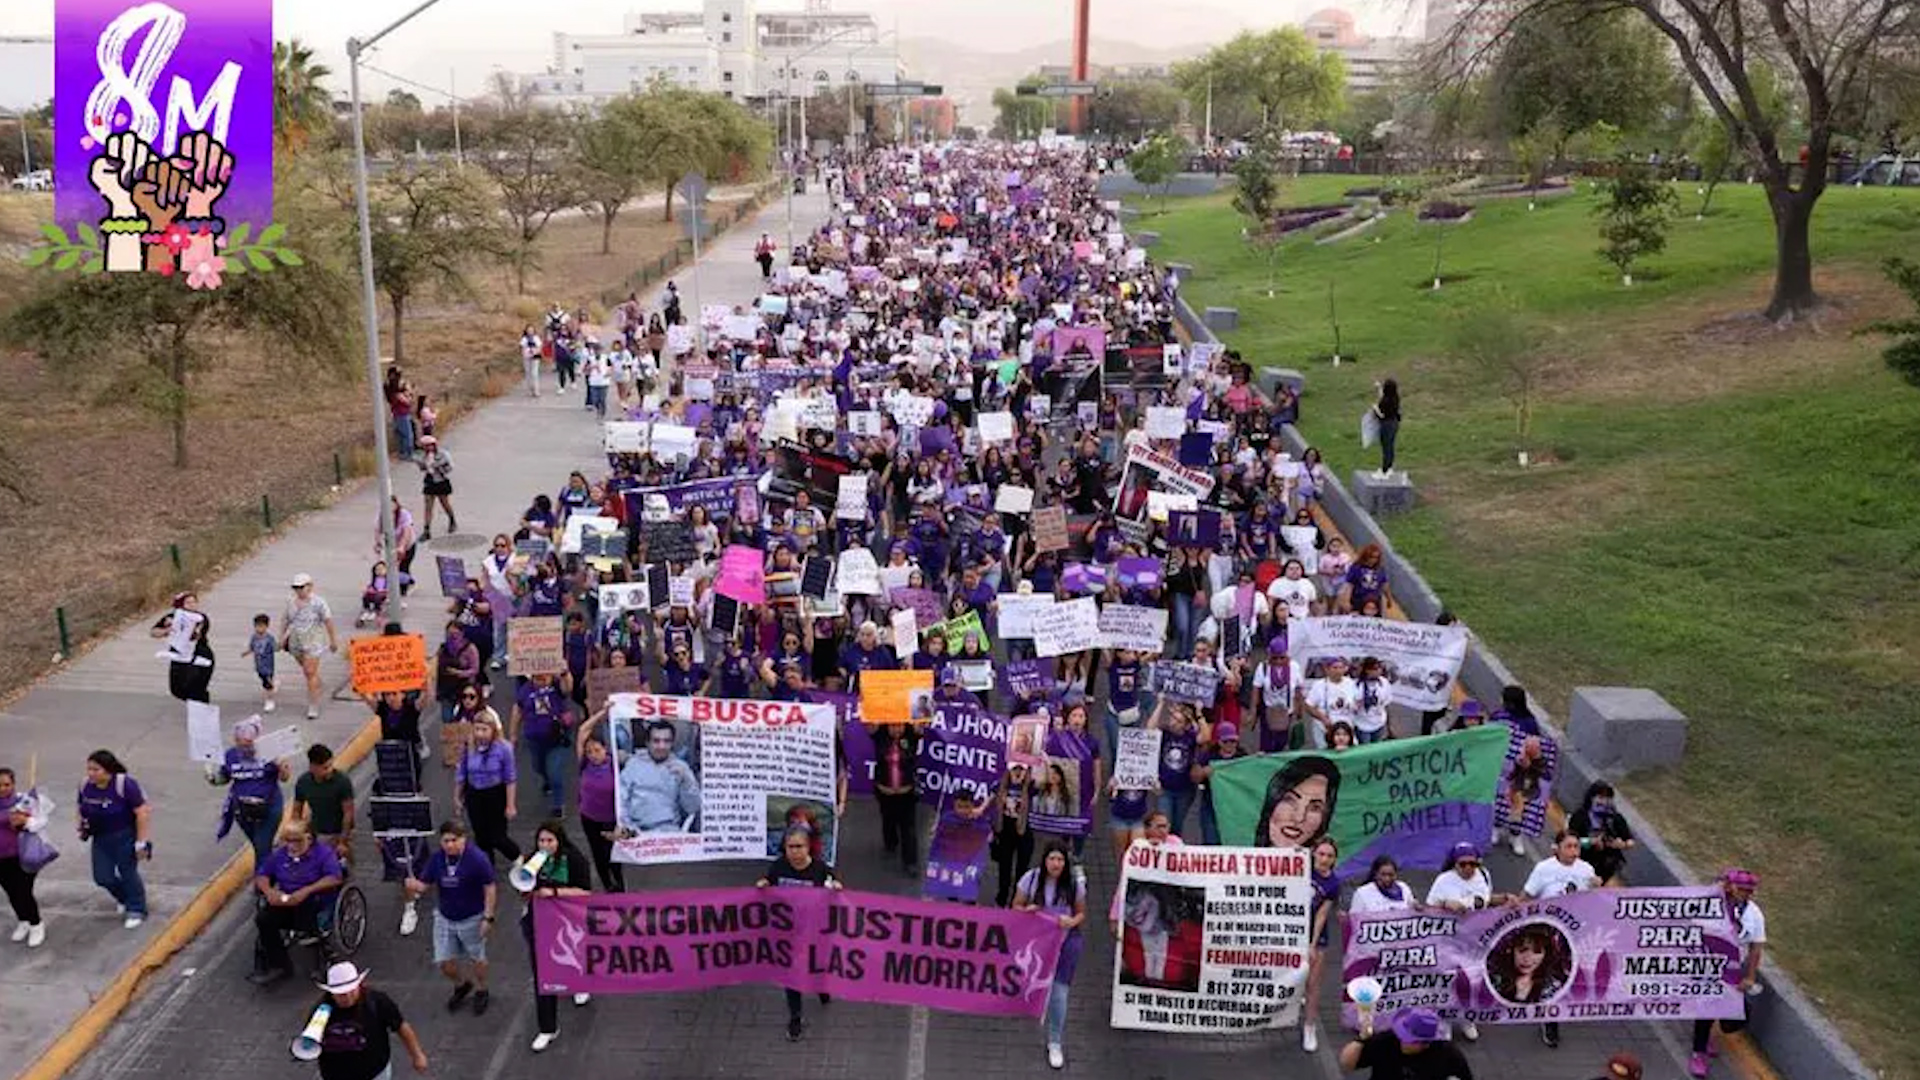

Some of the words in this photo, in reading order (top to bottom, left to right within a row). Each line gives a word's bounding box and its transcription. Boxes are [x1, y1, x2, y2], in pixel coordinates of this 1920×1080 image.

[637, 697, 678, 717] SE
[692, 700, 807, 725] BUSCA
[952, 714, 1010, 743] JHOA
[928, 741, 997, 773] GENTE
[1357, 749, 1468, 785] JUSTICIA
[1388, 778, 1444, 805] PARA
[1362, 802, 1474, 837] DANIELA
[1129, 847, 1161, 868] SOY
[1166, 852, 1238, 875] DANIELA
[1243, 854, 1305, 877] TOVAR
[1239, 886, 1255, 897] NO
[1258, 886, 1286, 898] PUDE
[1207, 901, 1262, 916] REGRESAR
[1264, 902, 1273, 915] A
[1275, 904, 1305, 917] CASA
[1614, 897, 1724, 919] JUSTICIA
[586, 902, 795, 937] EXIGIMOS
[821, 907, 1010, 954] JUSTICIA
[1357, 916, 1457, 944] JUSTICIA
[1638, 926, 1704, 947] PARA
[586, 945, 674, 976] PARA
[692, 937, 792, 971] TODAS
[808, 947, 865, 982] LAS
[883, 955, 1024, 998] MORRAS
[1206, 949, 1301, 968] FEMINICIDIO
[1379, 944, 1437, 968] PARA
[1625, 956, 1726, 975] MALENY
[1231, 982, 1254, 995] 377
[1256, 983, 1274, 998] 98
[1631, 982, 1724, 996] 1991-2023
[1197, 999, 1260, 1014] RECUERDAS
[1464, 1009, 1501, 1021] QUE
[1507, 1007, 1528, 1018] YA
[1539, 1004, 1560, 1017] NO
[1567, 1002, 1636, 1017] TIENEN
[1642, 1002, 1681, 1015] VOZ
[1173, 1012, 1196, 1026] ESTE
[1199, 1015, 1244, 1028] VESTIDO
